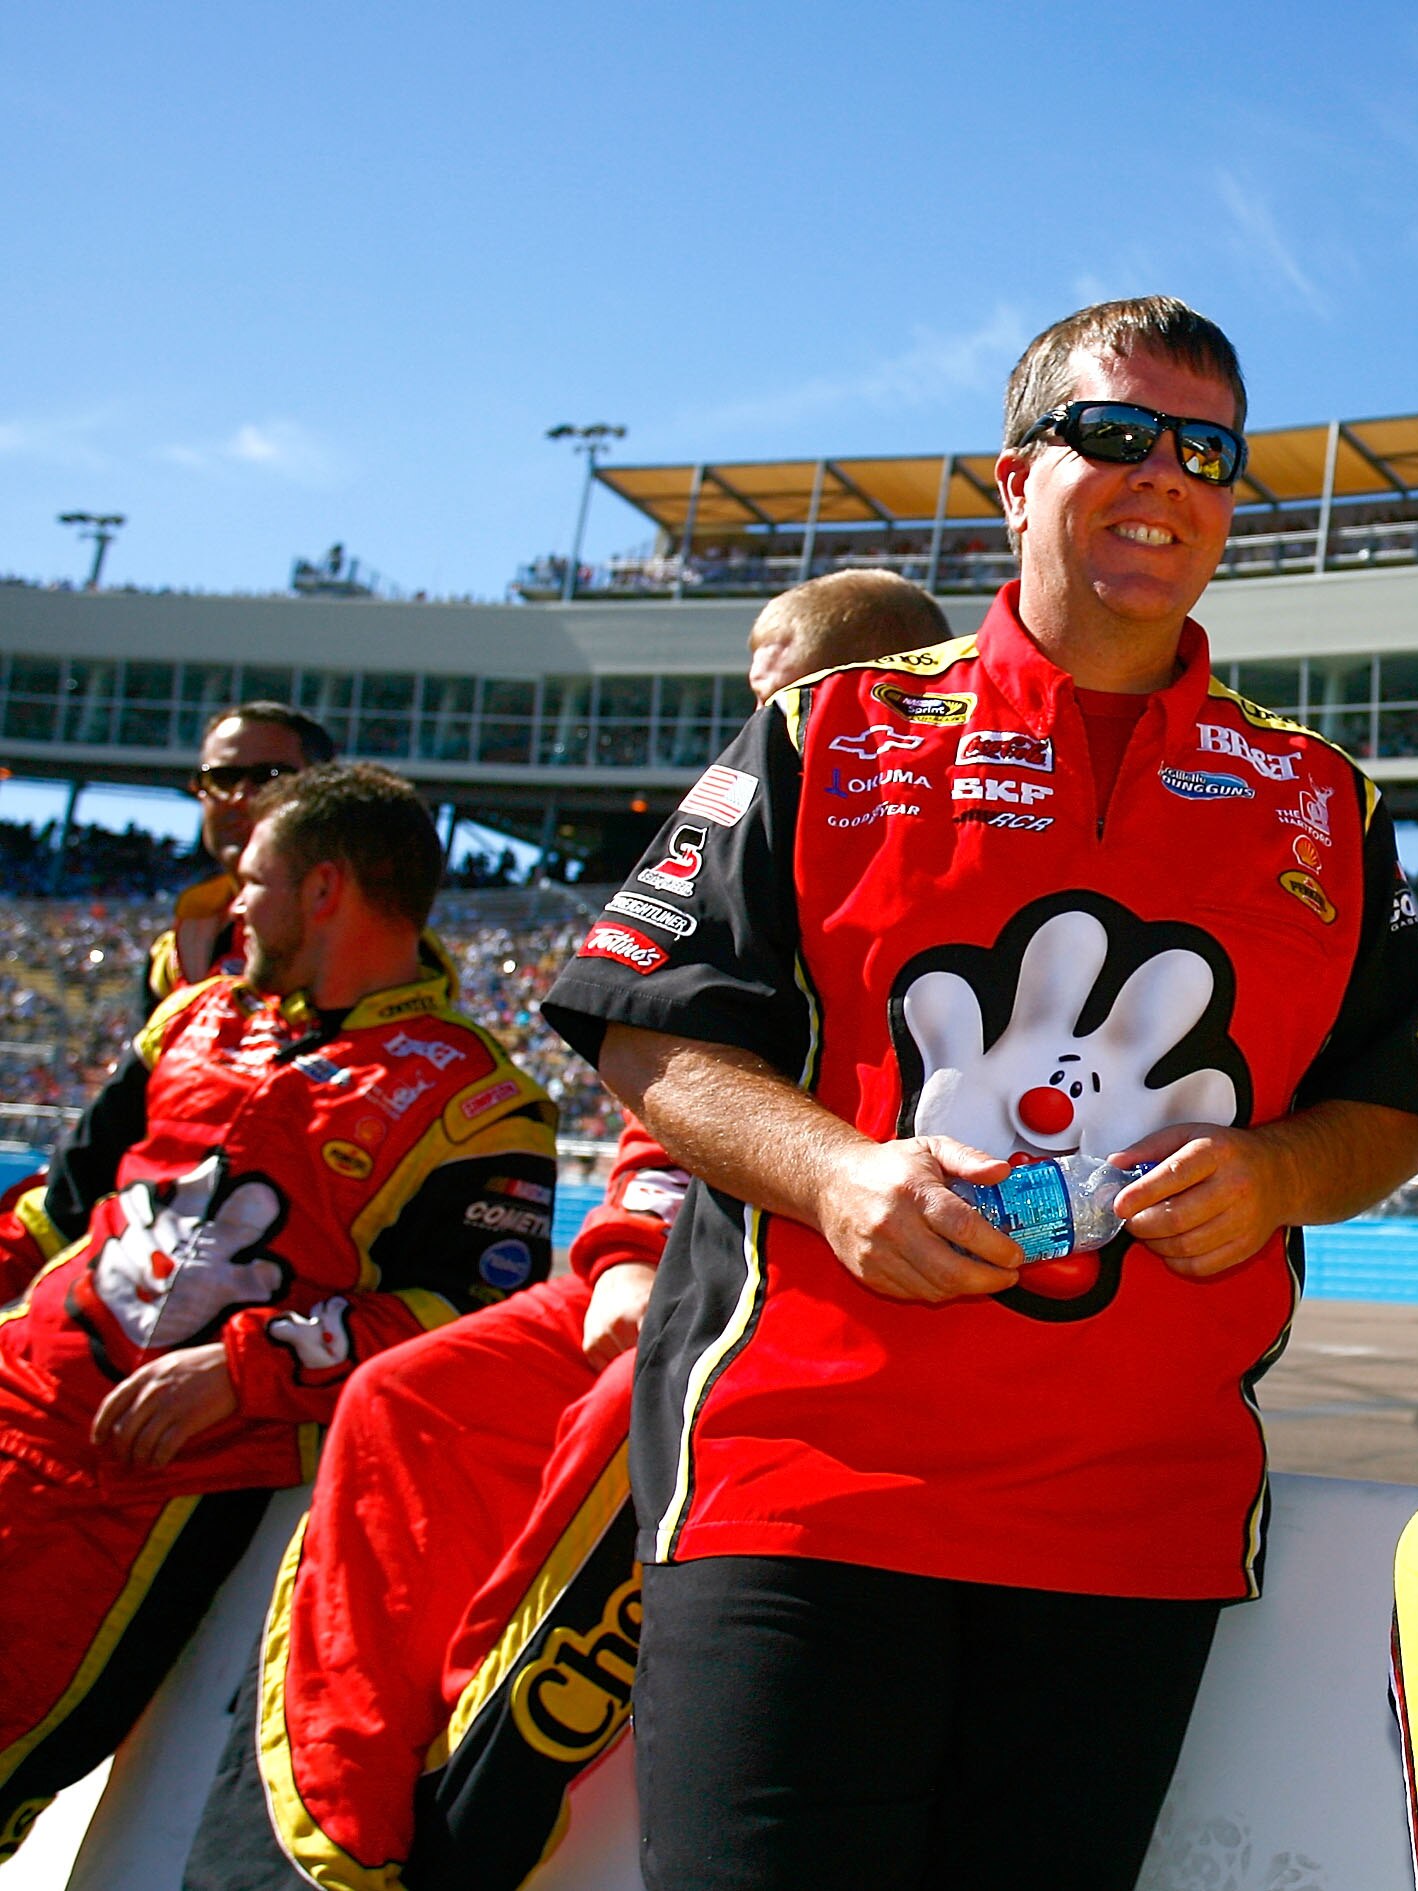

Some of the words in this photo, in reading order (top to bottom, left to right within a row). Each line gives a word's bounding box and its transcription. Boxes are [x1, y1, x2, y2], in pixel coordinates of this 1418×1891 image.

[1195, 722, 1302, 781] BB&T
[847, 769, 933, 793] OKUMA
[951, 778, 1054, 805] SKF
[827, 800, 921, 829] GOODYEAR
[1278, 817, 1333, 848] HARTFORD
[588, 928, 660, 966] Totino's
